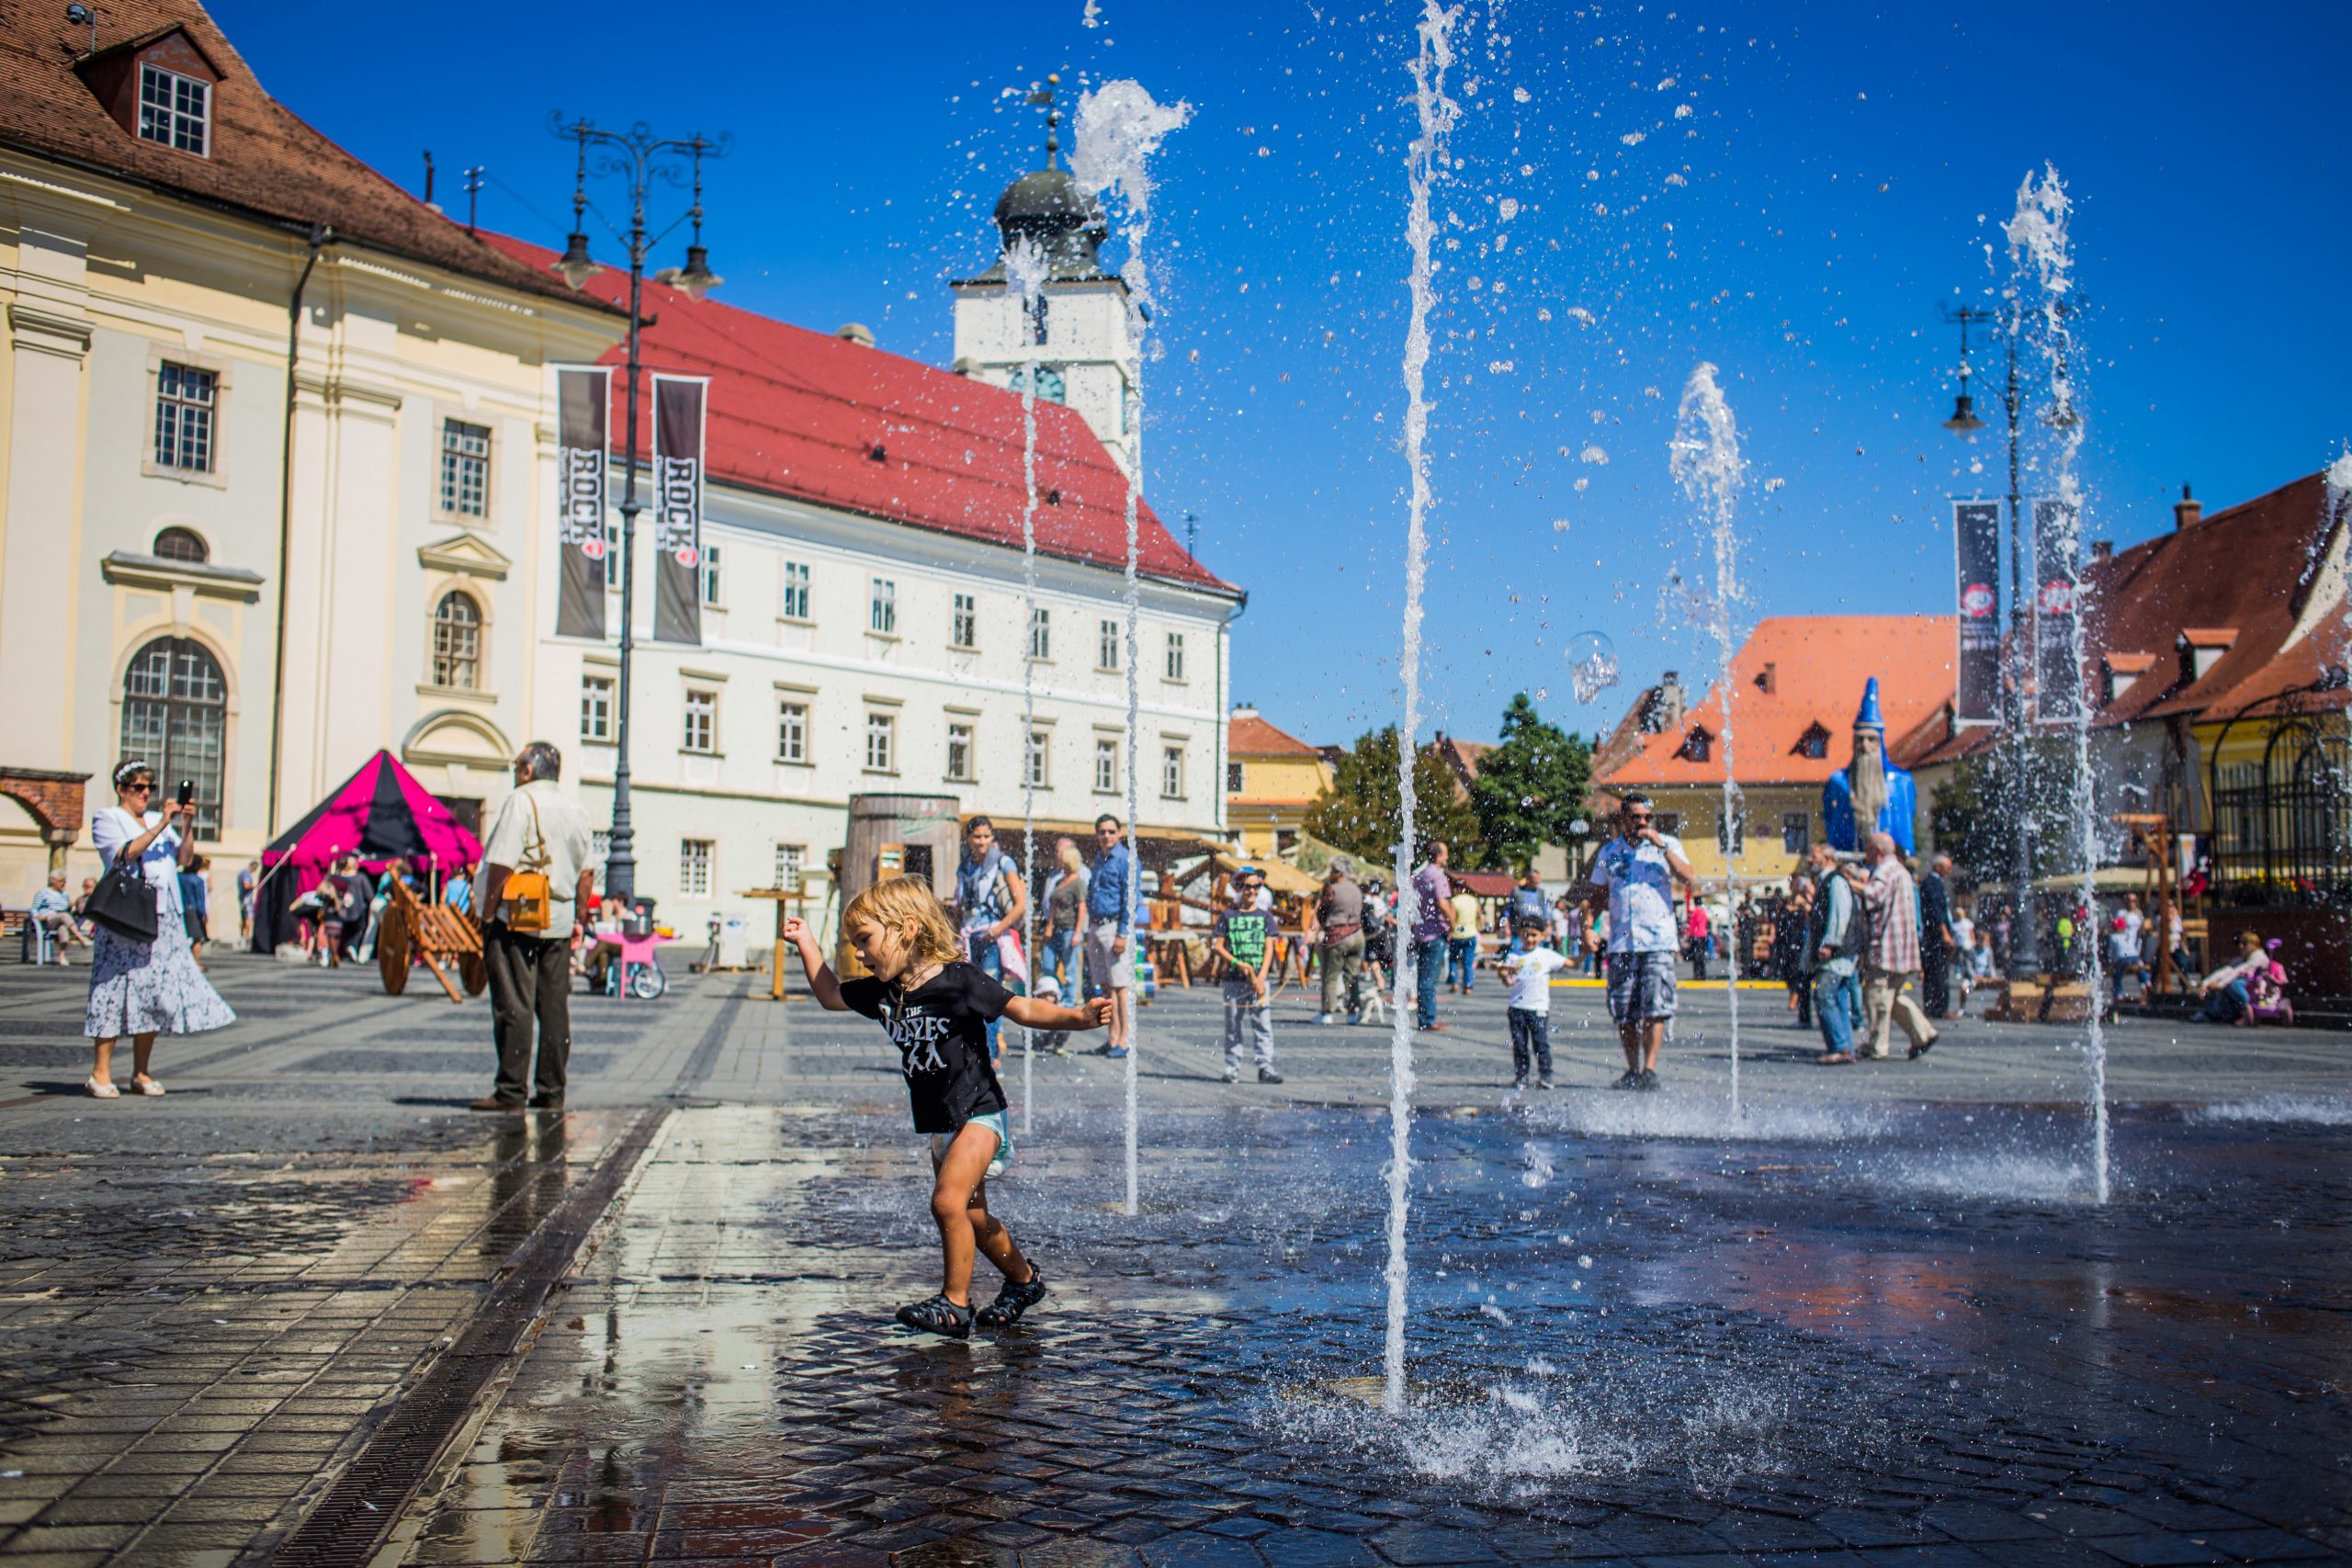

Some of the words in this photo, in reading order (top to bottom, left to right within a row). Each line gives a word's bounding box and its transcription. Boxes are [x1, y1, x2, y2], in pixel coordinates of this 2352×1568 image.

[569, 447, 602, 544] ROCK
[664, 457, 696, 552] ROCK
[878, 1003, 951, 1042] BEATLES
[906, 1006, 922, 1018] THE
